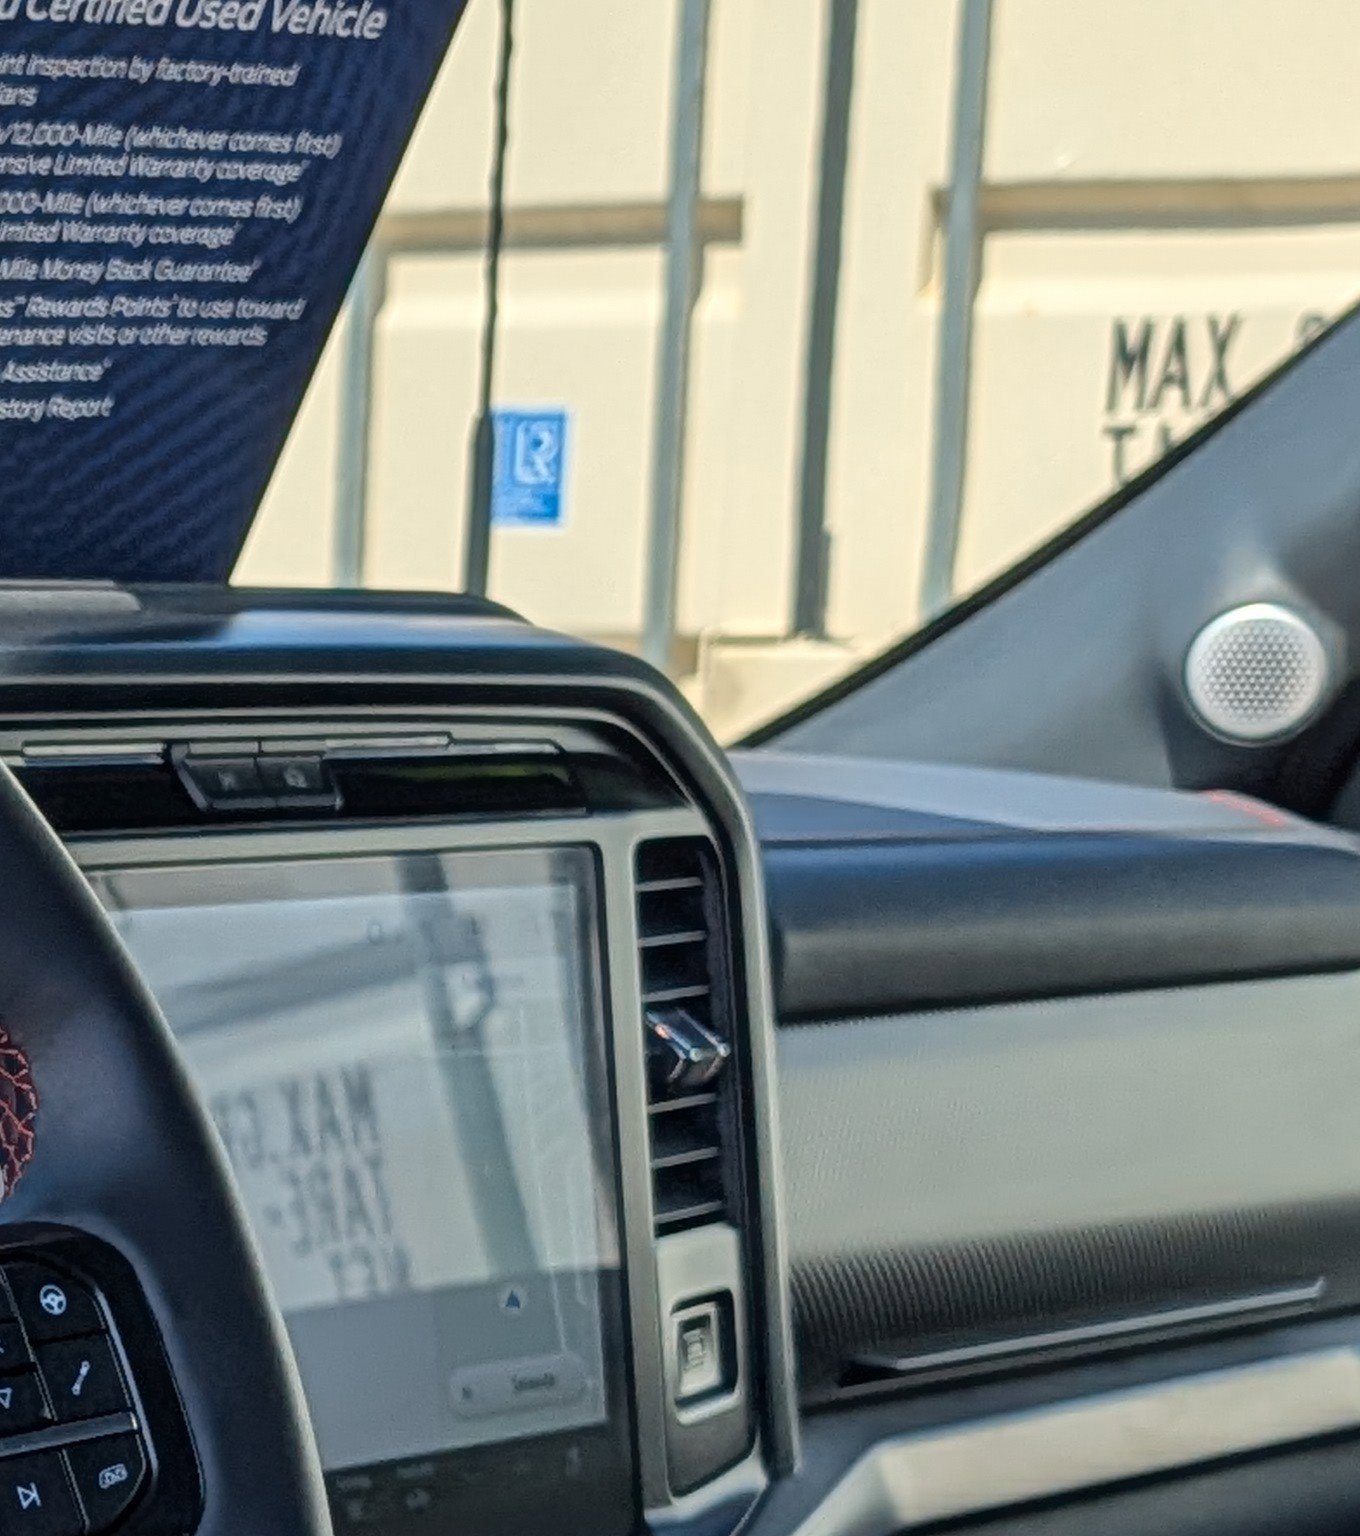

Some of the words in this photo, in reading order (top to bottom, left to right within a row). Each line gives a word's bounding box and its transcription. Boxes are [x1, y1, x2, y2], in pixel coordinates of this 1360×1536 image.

[174, 0, 262, 31] Used
[270, 0, 387, 40] Vehicle
[27, 53, 128, 81] inspection
[129, 56, 154, 83] by
[154, 58, 300, 87] factory-trained
[229, 132, 293, 154] comes
[53, 150, 128, 177] Limited
[128, 154, 215, 183] Warranty
[189, 197, 254, 218] comes
[62, 218, 148, 248] Warranty
[40, 256, 104, 285] Money
[105, 256, 154, 282] Back
[25, 296, 110, 319] Rewards
[177, 299, 198, 319] to
[199, 302, 235, 320] use
[235, 297, 307, 321] toward
[68, 322, 117, 346] visits
[117, 327, 140, 346] or
[191, 323, 268, 347] rewards
[1104, 308, 1242, 412] MAX
[46, 394, 115, 422] Report
